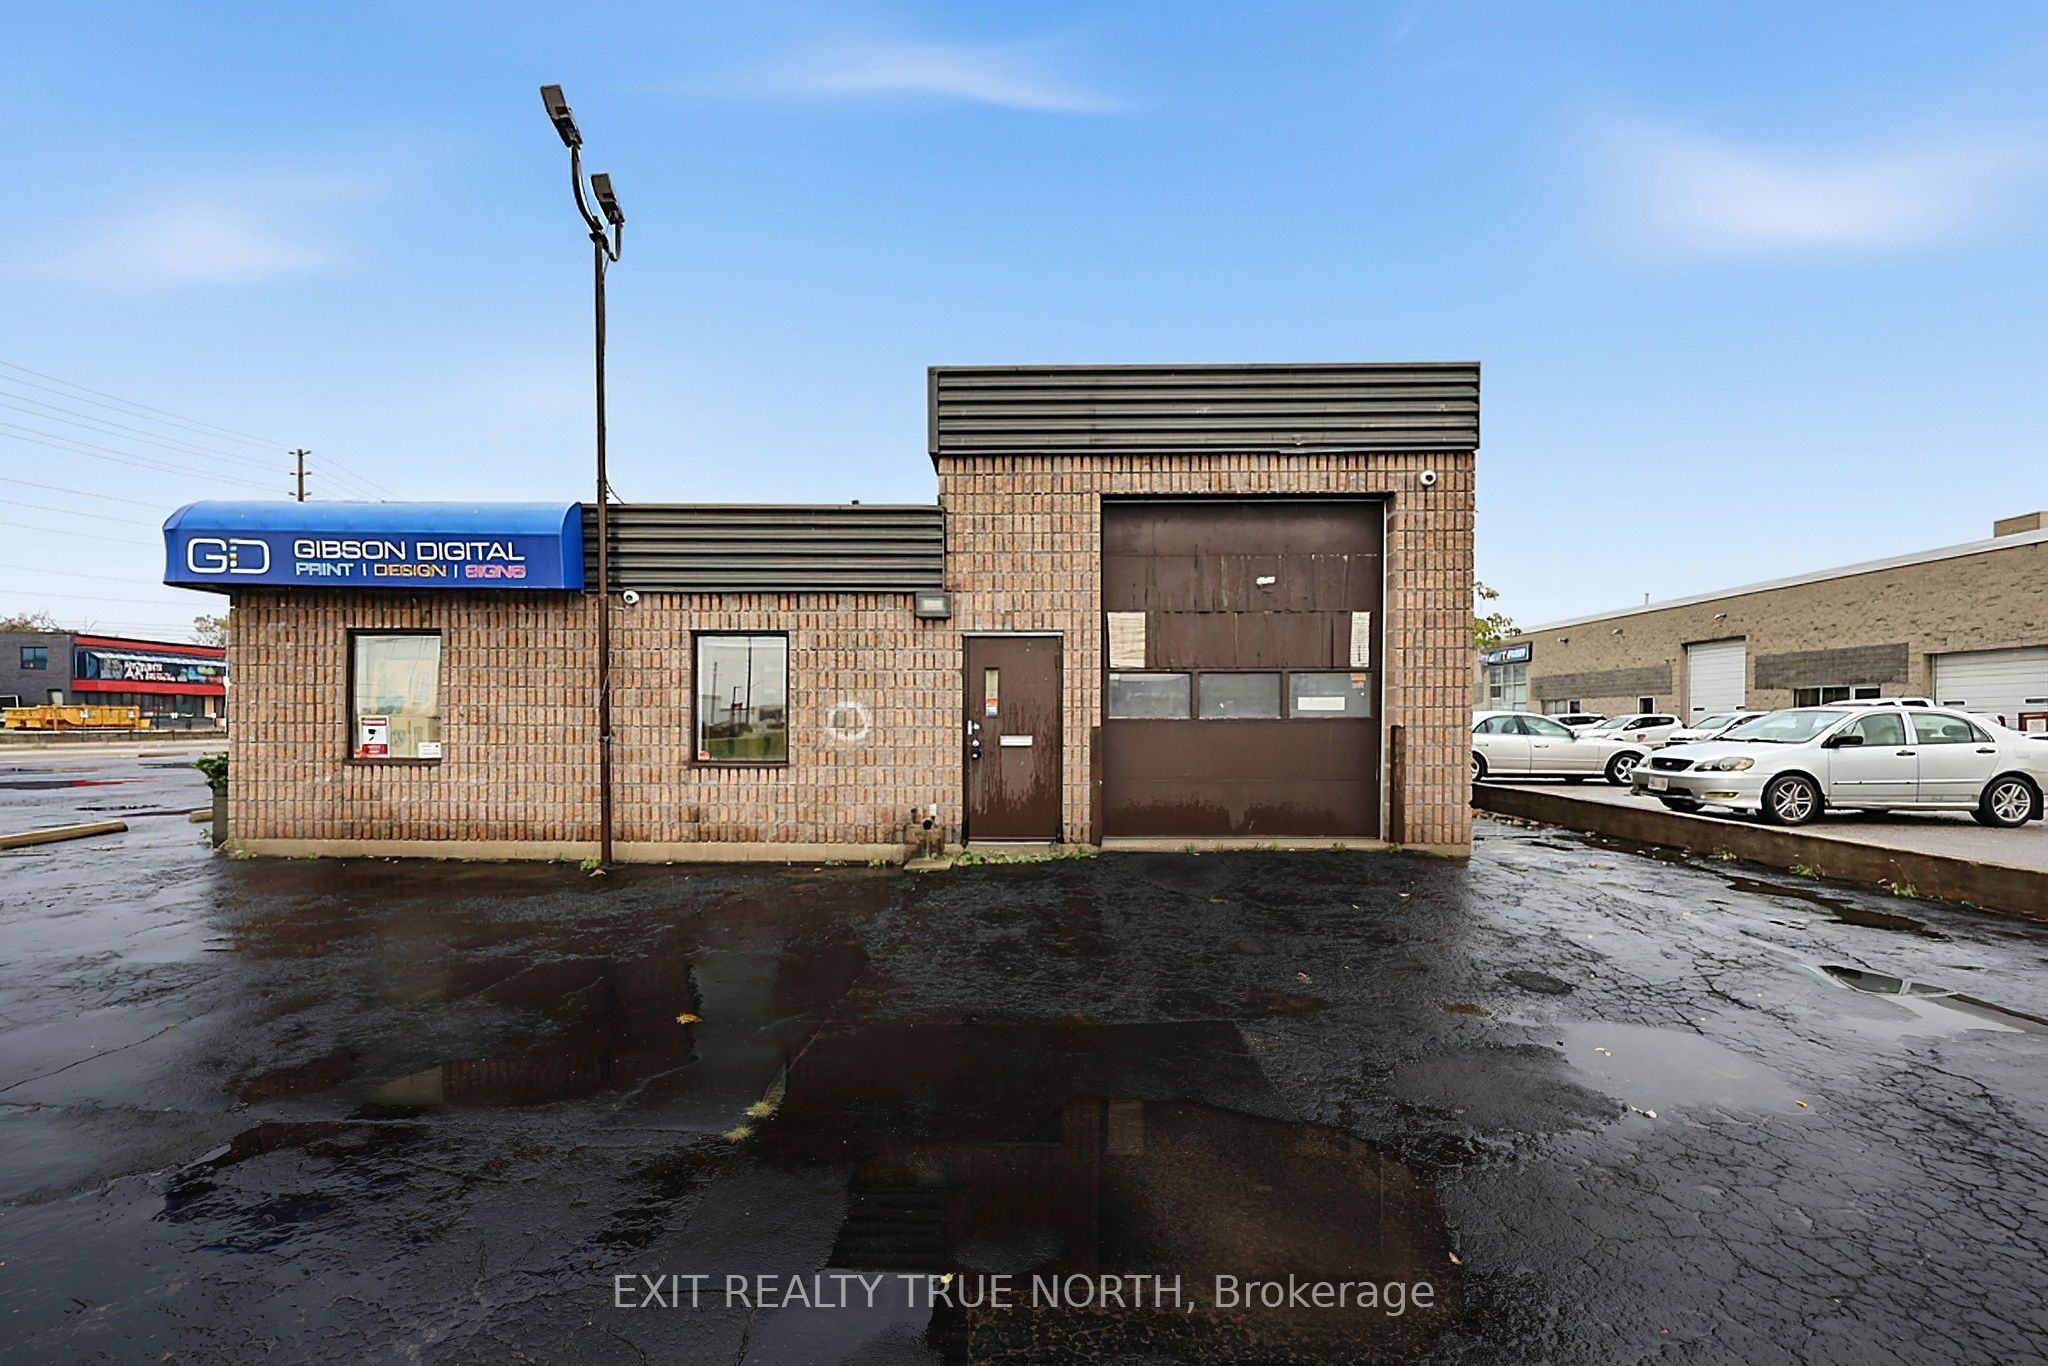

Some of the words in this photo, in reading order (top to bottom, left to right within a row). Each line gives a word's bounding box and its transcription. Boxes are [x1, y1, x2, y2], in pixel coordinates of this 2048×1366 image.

[293, 540, 405, 560] GIBSON
[416, 542, 525, 562] DIGITAL
[296, 562, 354, 577] PRINT
[373, 563, 447, 578] DESIGN
[464, 564, 526, 579] SIGNS
